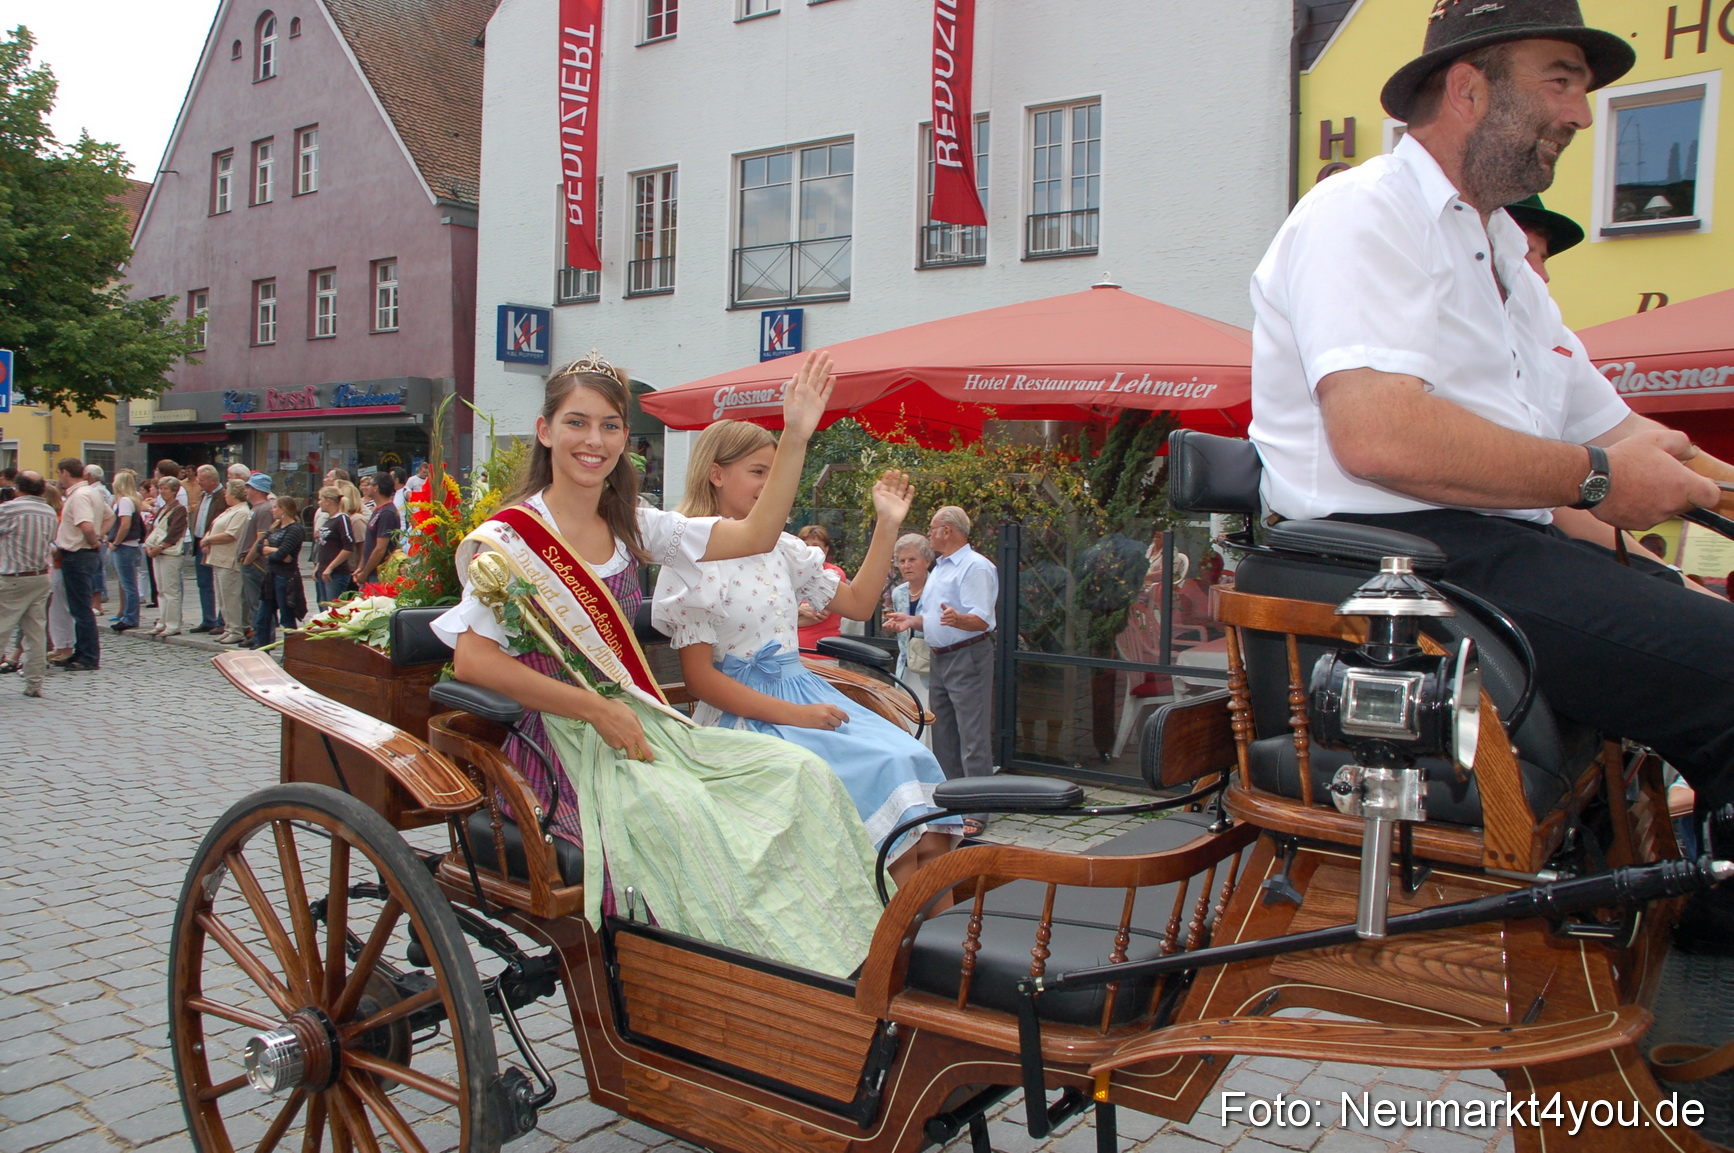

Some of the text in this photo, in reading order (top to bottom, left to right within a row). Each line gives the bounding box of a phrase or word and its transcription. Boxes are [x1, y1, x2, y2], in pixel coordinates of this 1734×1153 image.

[963, 371, 1218, 399] Hotel Restaurant Lehmeier
[512, 548, 633, 689] Dietfurt a. d. Altmühl
[541, 545, 625, 662] Siebentälerkönigin
